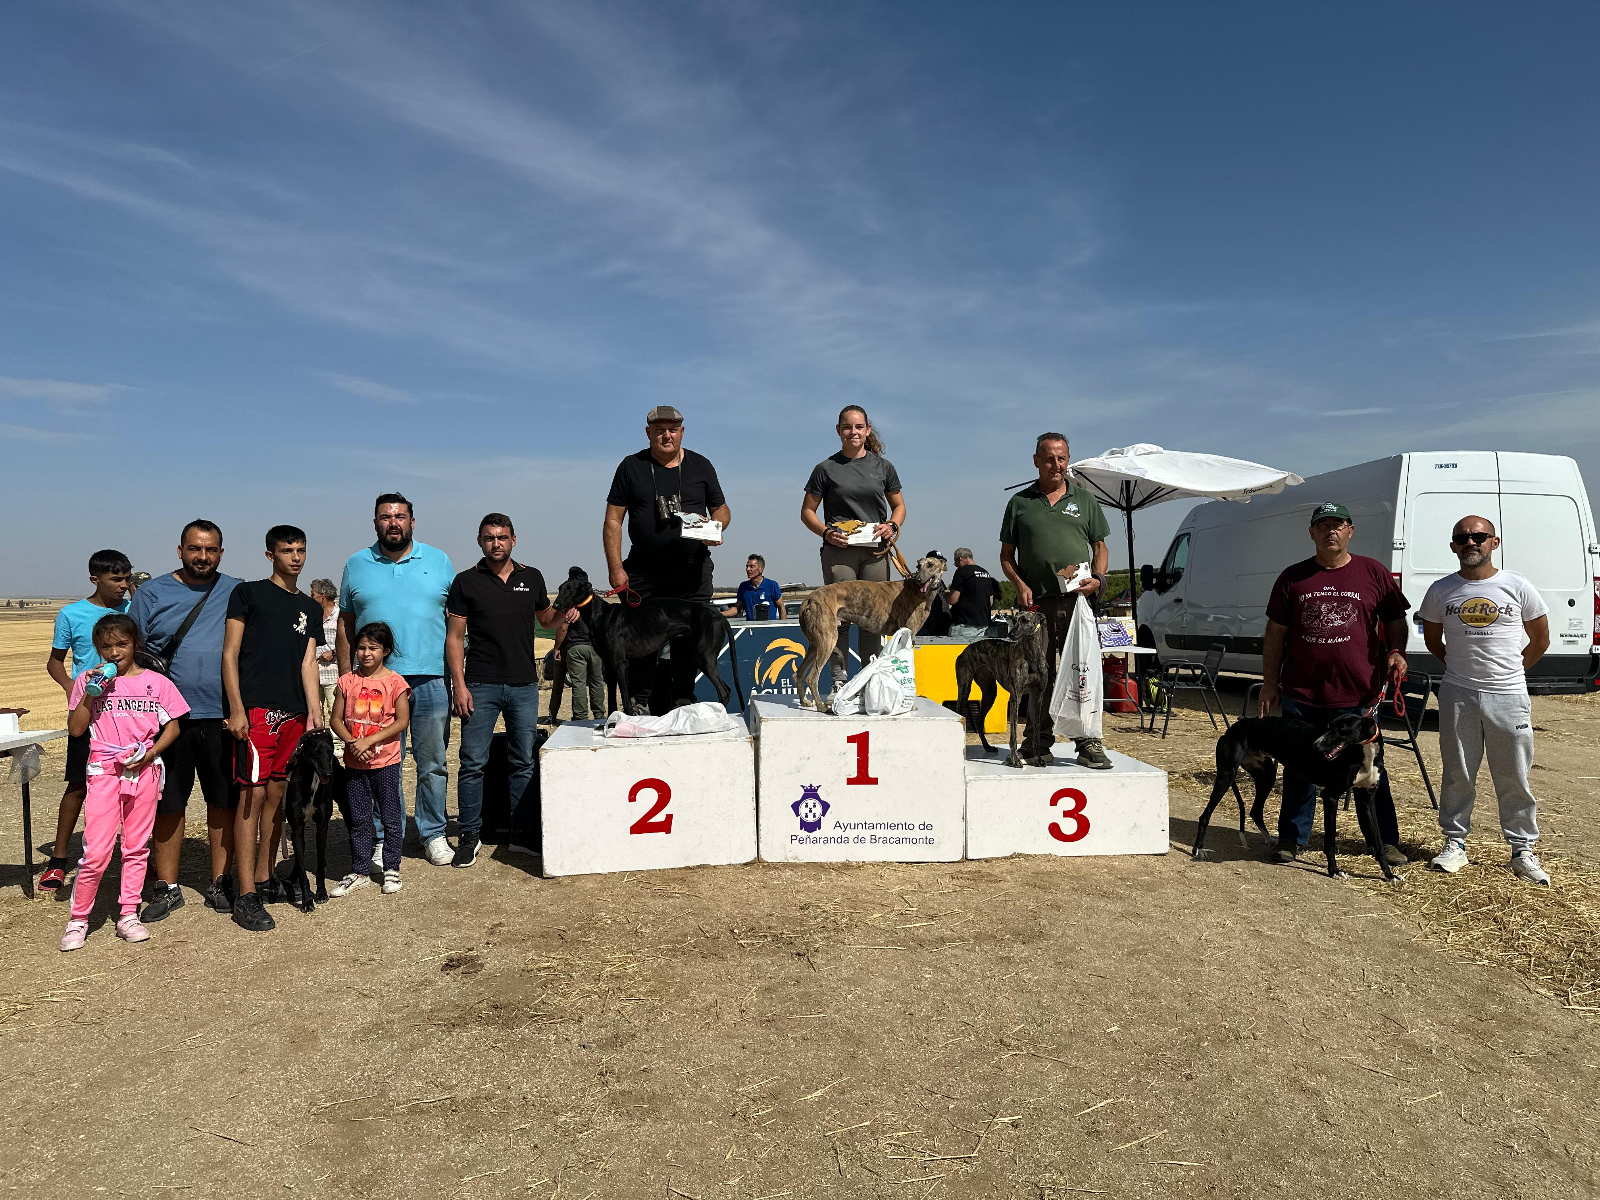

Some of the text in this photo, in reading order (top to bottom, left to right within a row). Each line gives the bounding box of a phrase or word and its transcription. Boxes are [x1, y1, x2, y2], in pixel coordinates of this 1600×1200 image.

[1341, 591, 1361, 600] CORRAL
[1444, 602, 1513, 616] Hard Rock
[781, 678, 792, 687] EL
[117, 699, 159, 713] ANGELES
[846, 730, 879, 785] 1
[628, 777, 674, 835] 2
[1048, 787, 1091, 843] 3
[833, 821, 934, 832] Ayuntamiento de
[790, 834, 935, 845] Peñaranda de Bracamonte
